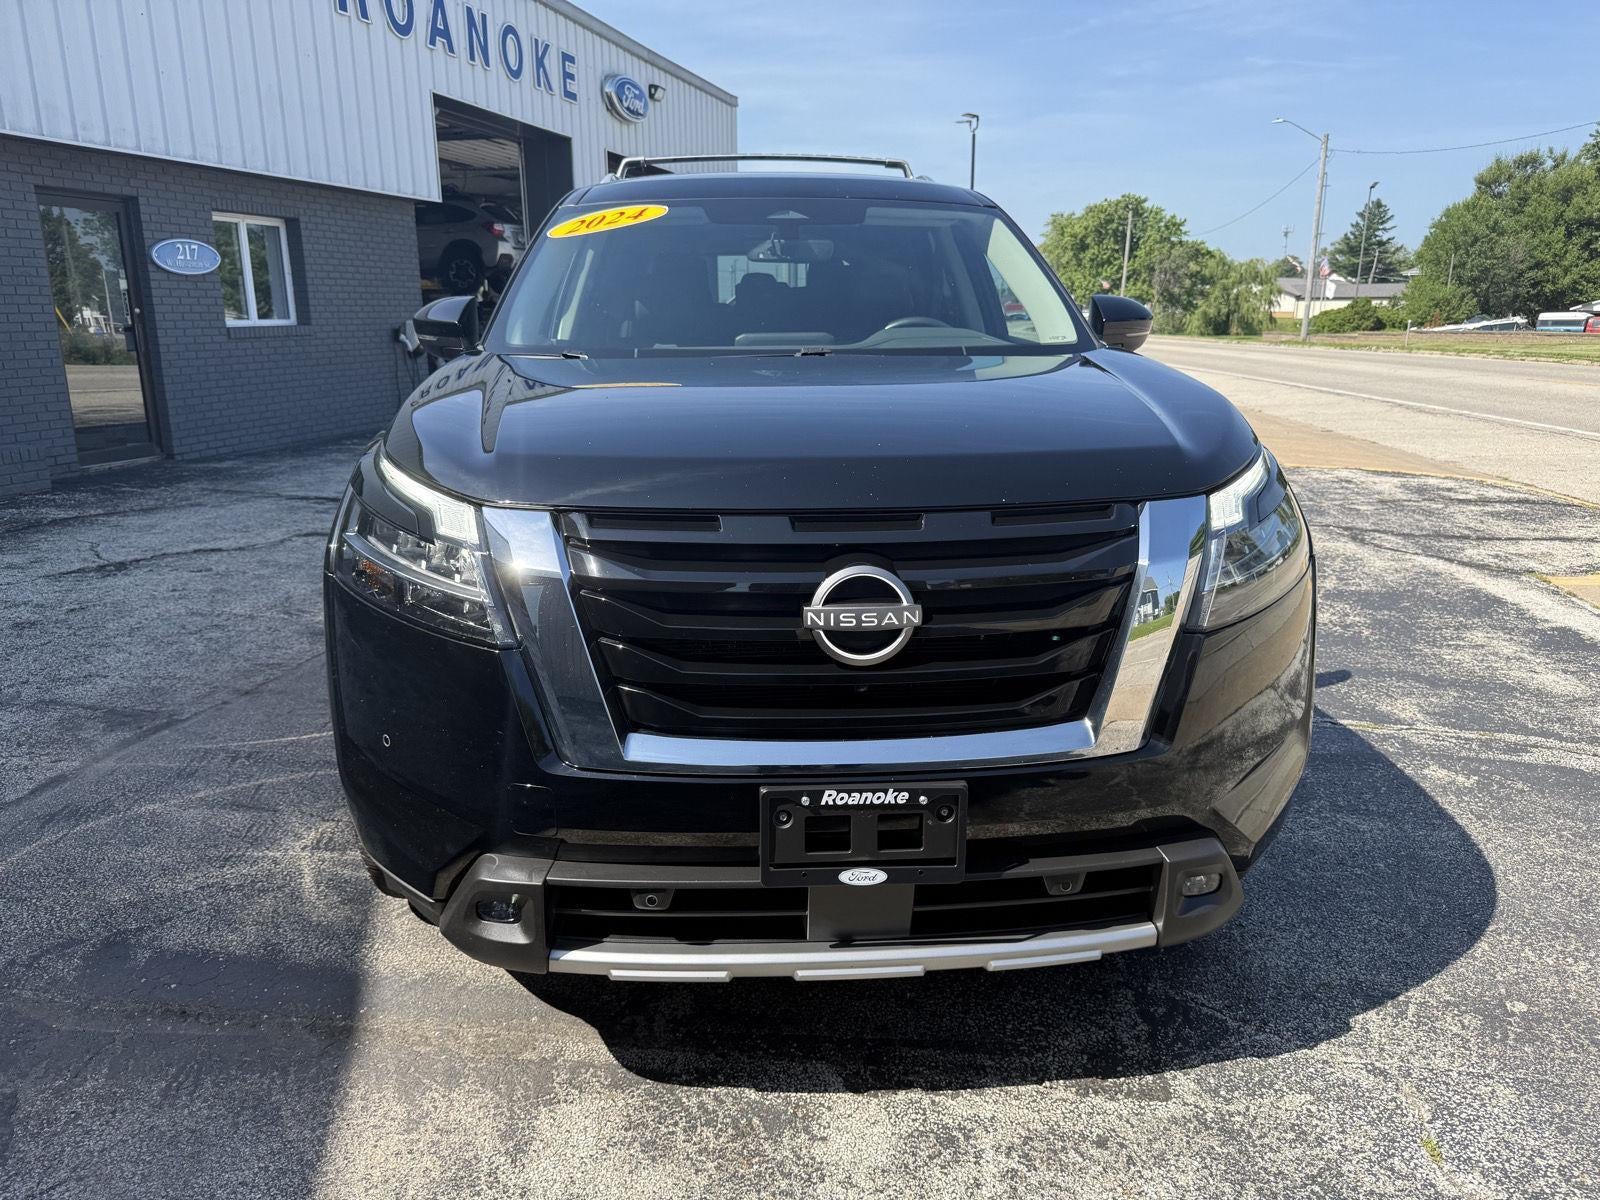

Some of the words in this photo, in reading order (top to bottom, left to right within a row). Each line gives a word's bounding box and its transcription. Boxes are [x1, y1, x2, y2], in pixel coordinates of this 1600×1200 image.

[622, 84, 646, 114] Ford
[564, 207, 649, 235] 2024
[175, 243, 199, 260] 217
[806, 609, 920, 627] NISSAN
[820, 788, 910, 806] Roanoke
[847, 871, 878, 883] Ford
